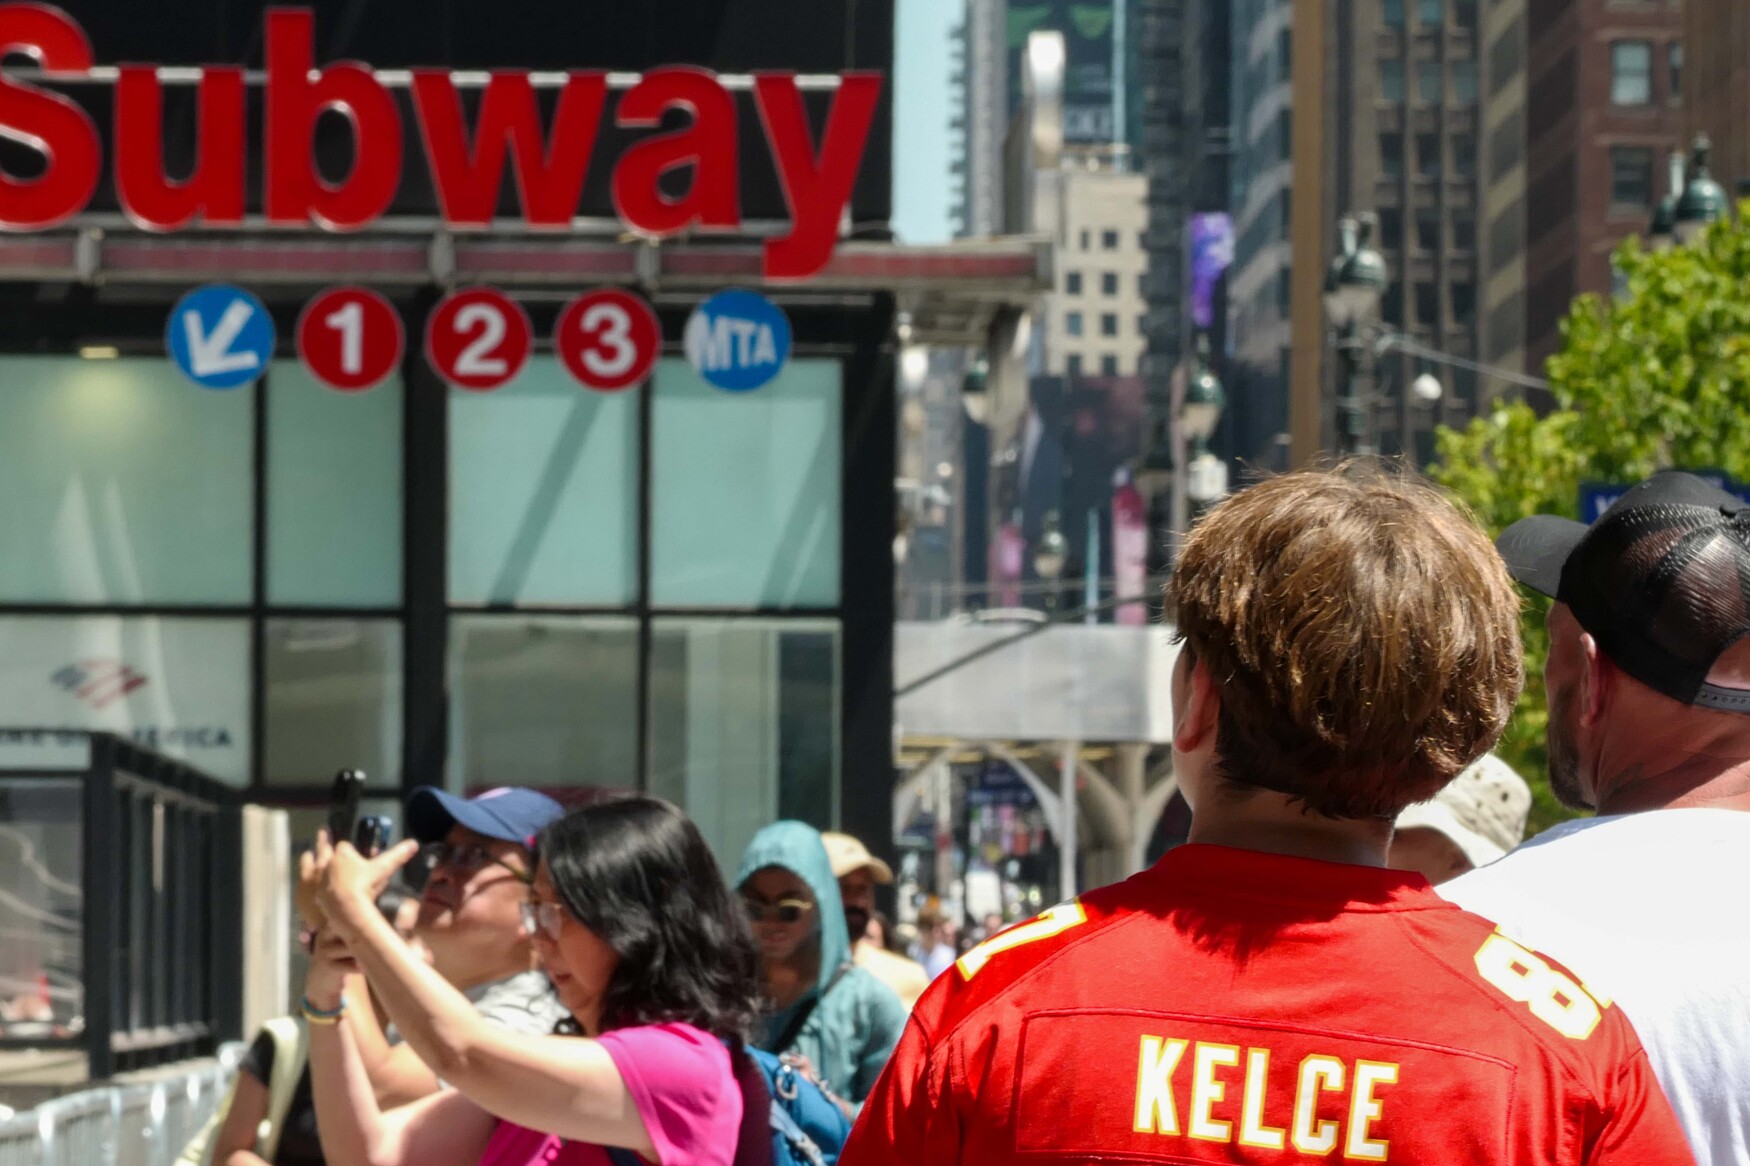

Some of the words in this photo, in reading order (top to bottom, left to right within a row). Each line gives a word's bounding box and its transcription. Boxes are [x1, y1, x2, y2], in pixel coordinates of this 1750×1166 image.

[0, 3, 883, 281] Subway
[327, 302, 364, 374] 1
[450, 309, 509, 376] 2
[579, 304, 639, 378] 3
[686, 311, 778, 372] MTA
[1132, 1033, 1400, 1162] KELCE
